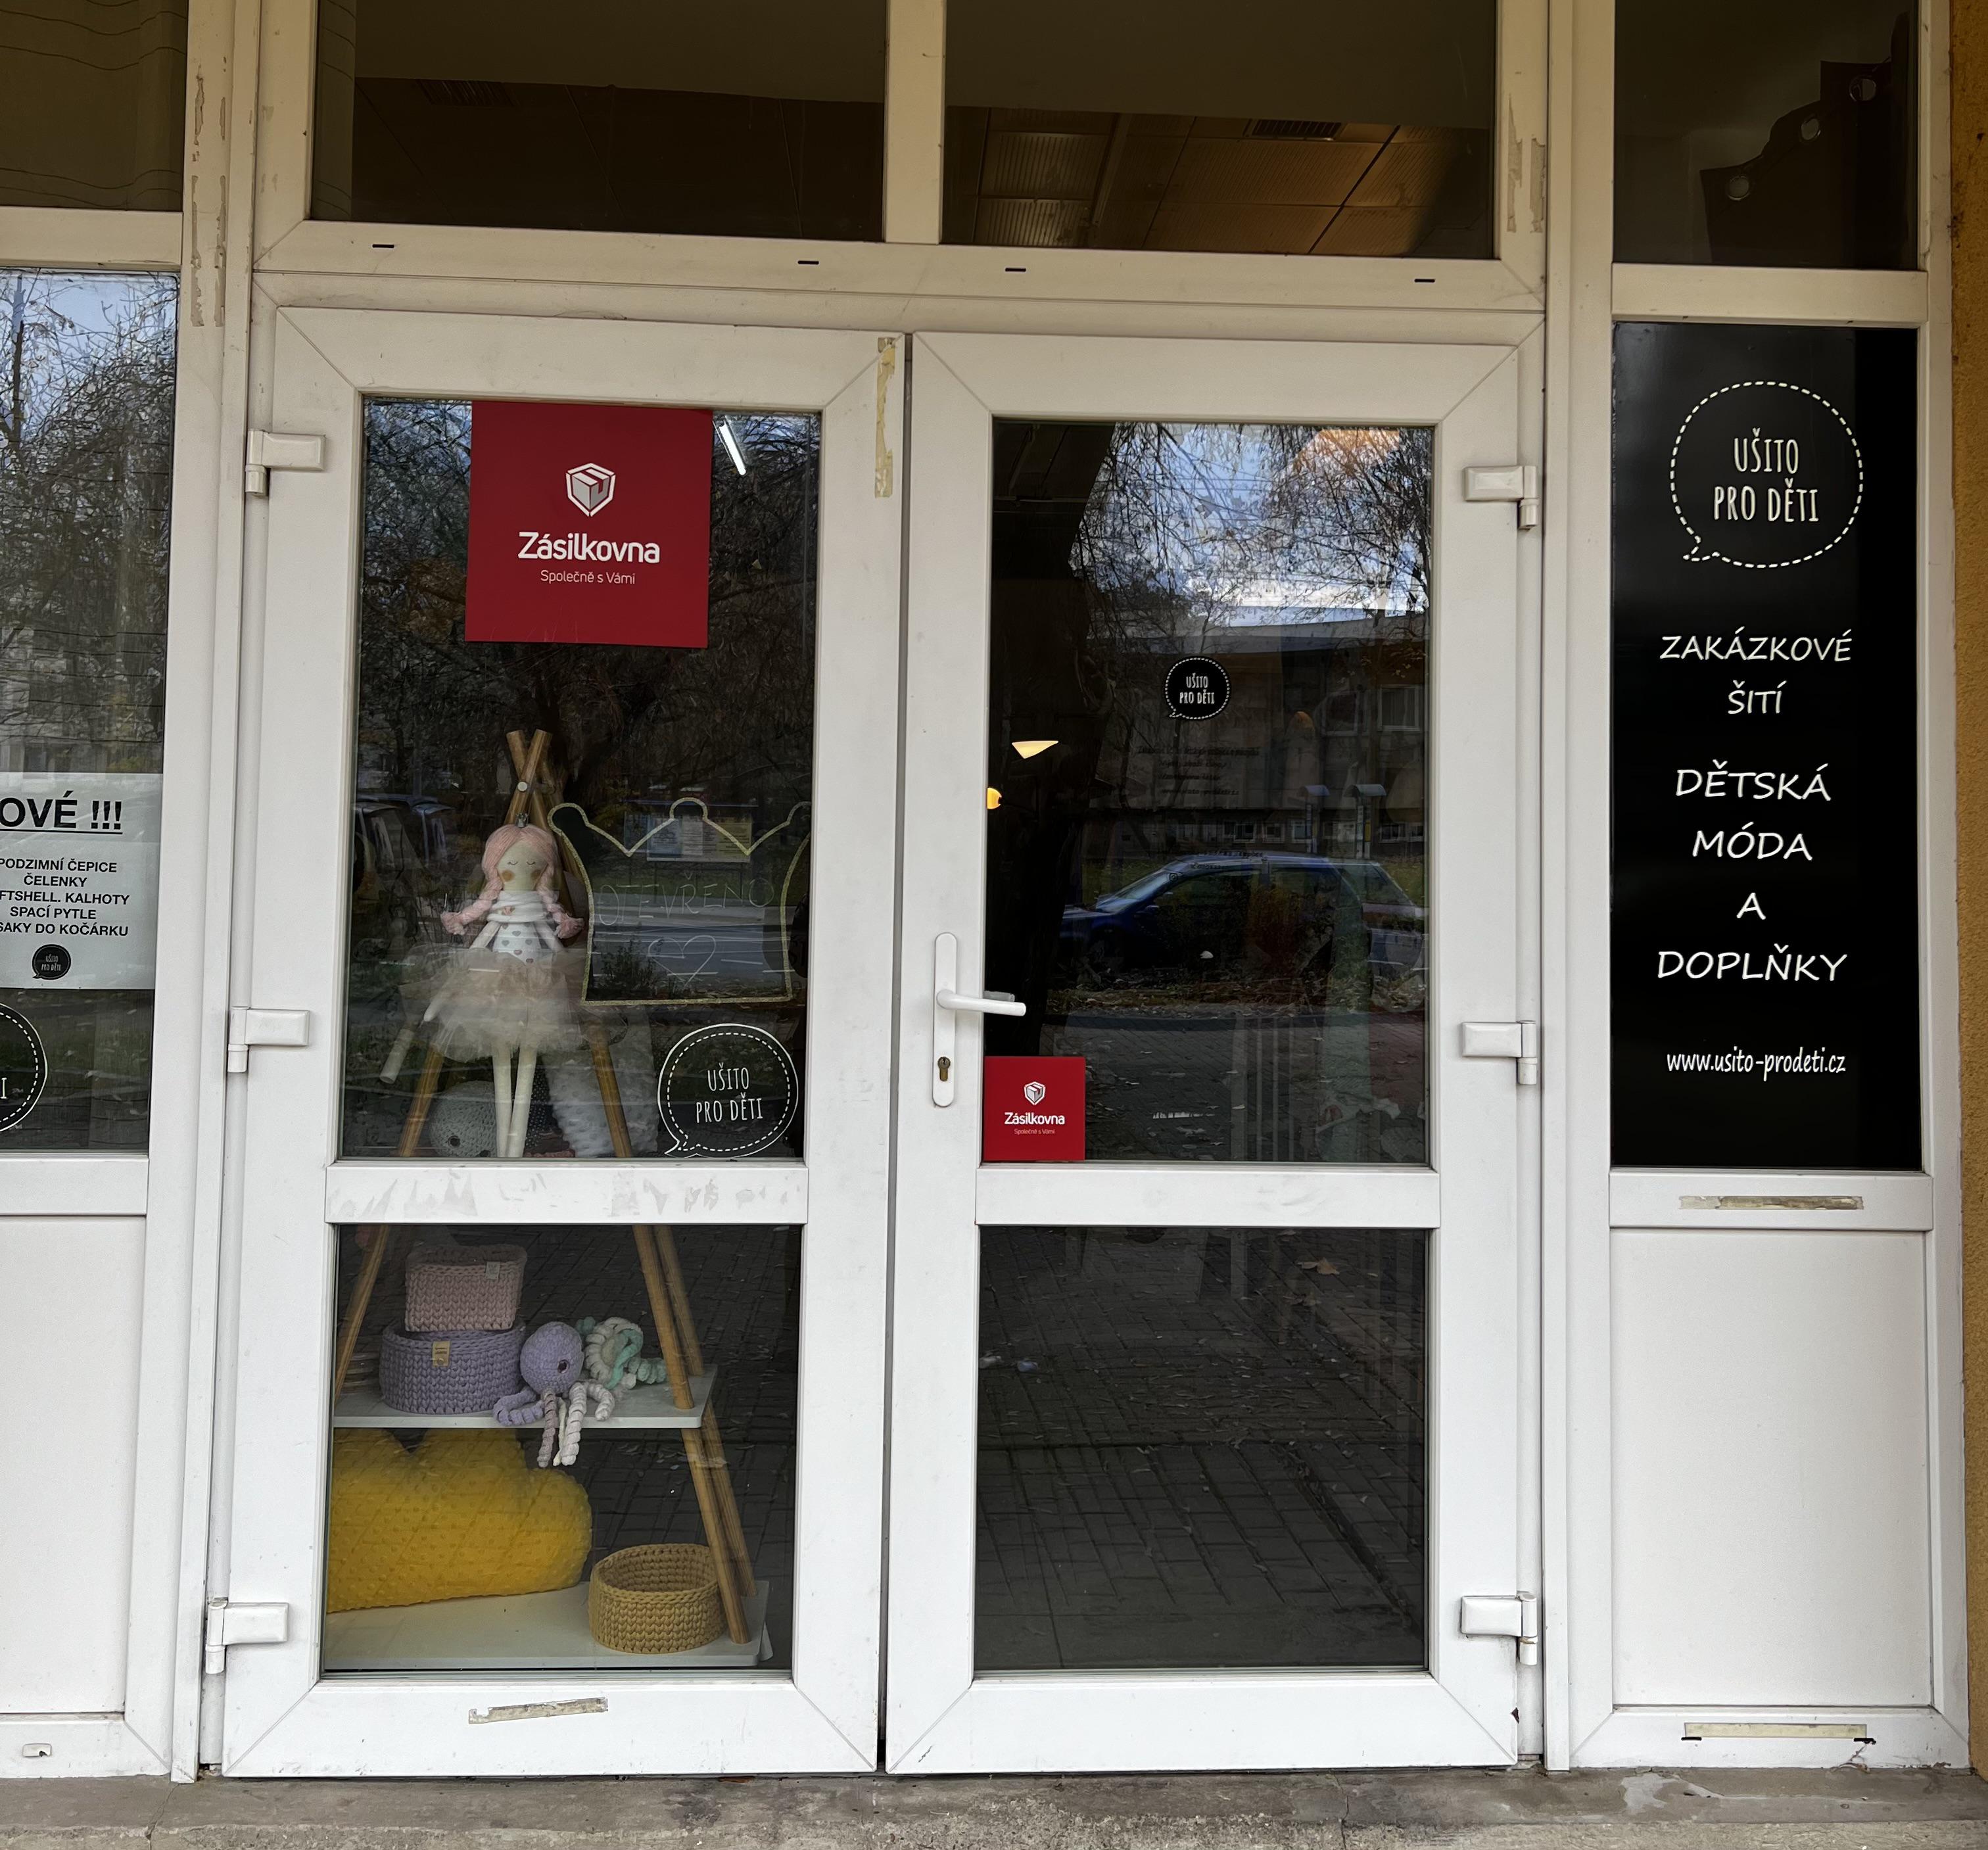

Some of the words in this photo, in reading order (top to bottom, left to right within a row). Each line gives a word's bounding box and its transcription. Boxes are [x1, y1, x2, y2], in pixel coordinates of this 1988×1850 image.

[1734, 427, 1799, 474] UŠITO
[1713, 485, 1756, 521] PRO
[1768, 477, 1819, 523] DĚTI
[517, 531, 660, 563] Zásilkovna
[540, 569, 594, 584] Společně
[597, 574, 604, 583] s
[605, 572, 636, 584] Vámi
[1660, 626, 1852, 661] ZAKÁZKOVÉ
[1185, 673, 1208, 688] UŠITO
[1179, 692, 1195, 704] PRO
[1197, 689, 1215, 704] DĚTI
[1728, 680, 1787, 714] ŠITÍ
[1676, 759, 1832, 801] DĚTSKÁ
[91, 800, 122, 830] !!!
[1692, 822, 1813, 861] MÓDA
[67, 858, 118, 872] ČEPICE
[24, 872, 87, 888] ČELENKY
[10, 905, 51, 918] SPACÍ
[54, 908, 97, 920] PYTLE
[65, 892, 130, 905] KALHOTY
[1736, 892, 1766, 920] A
[35, 923, 55, 934] DO
[59, 922, 129, 937] KOČÁRKU
[1657, 943, 1847, 981] DOPLŇKY
[707, 1062, 749, 1091] UŠITO
[1667, 1046, 1846, 1081] www.usito-prodeti.cz
[696, 1100, 722, 1124] PRO
[730, 1091, 763, 1121] DĚTI
[1004, 1112, 1065, 1125] Zásilkovna
